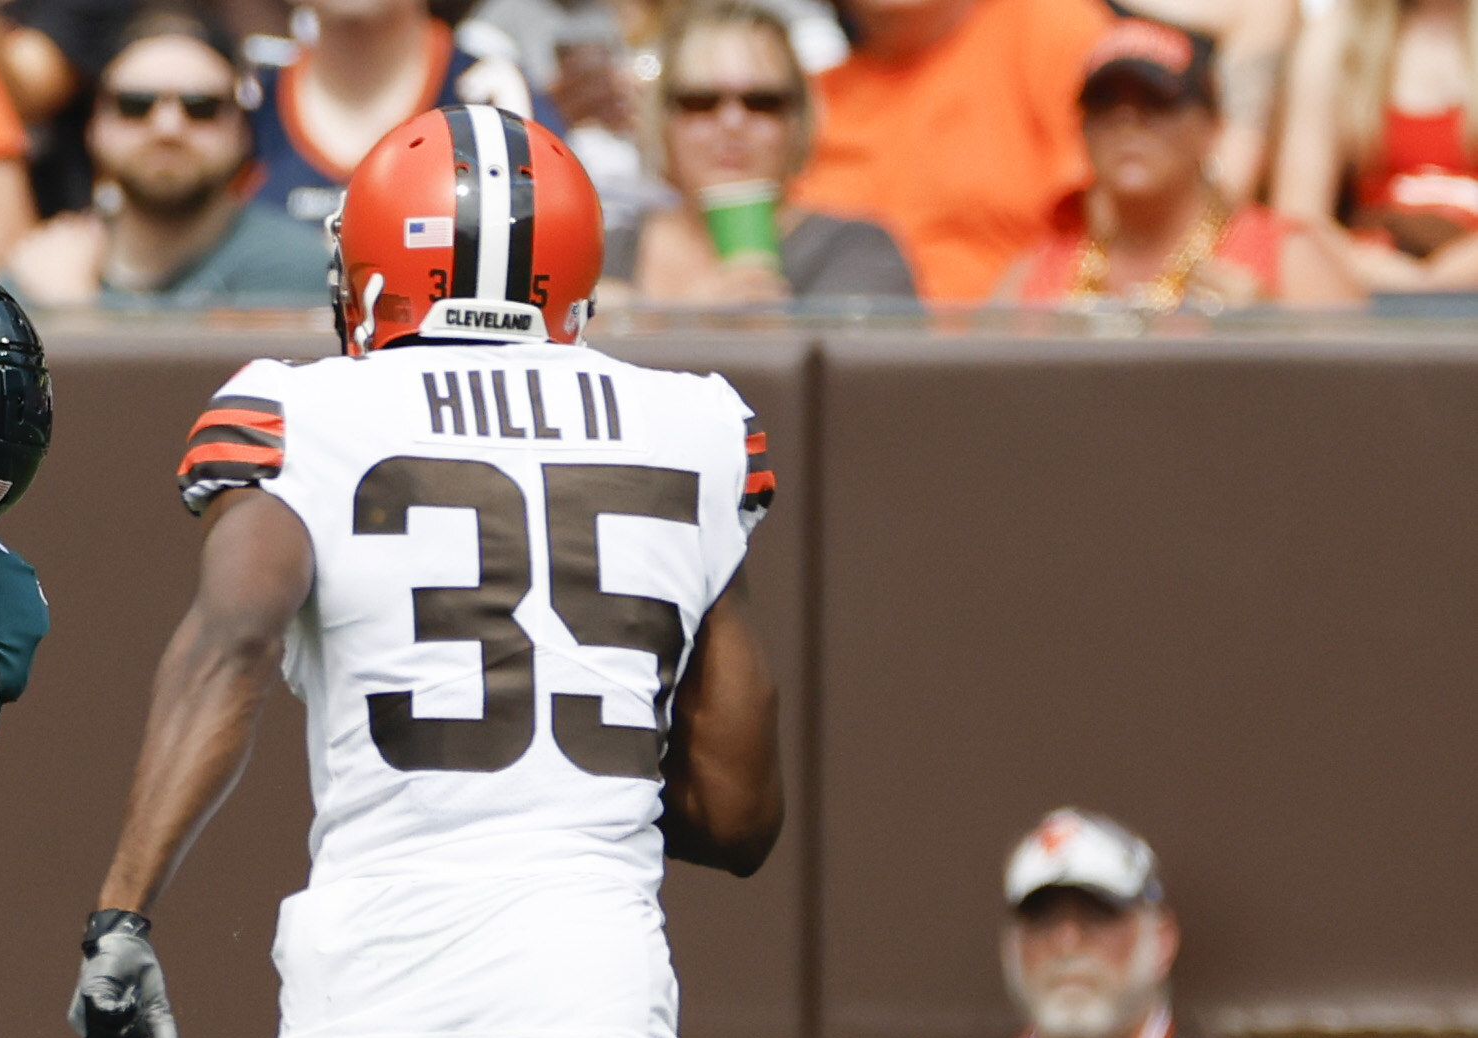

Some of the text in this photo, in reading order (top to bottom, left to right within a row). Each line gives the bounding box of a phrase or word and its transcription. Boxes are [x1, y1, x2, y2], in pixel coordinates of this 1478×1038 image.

[429, 268, 550, 308] 3 5
[445, 308, 533, 331] CLEVELAND
[422, 369, 622, 441] HILL II
[352, 455, 700, 781] 35
